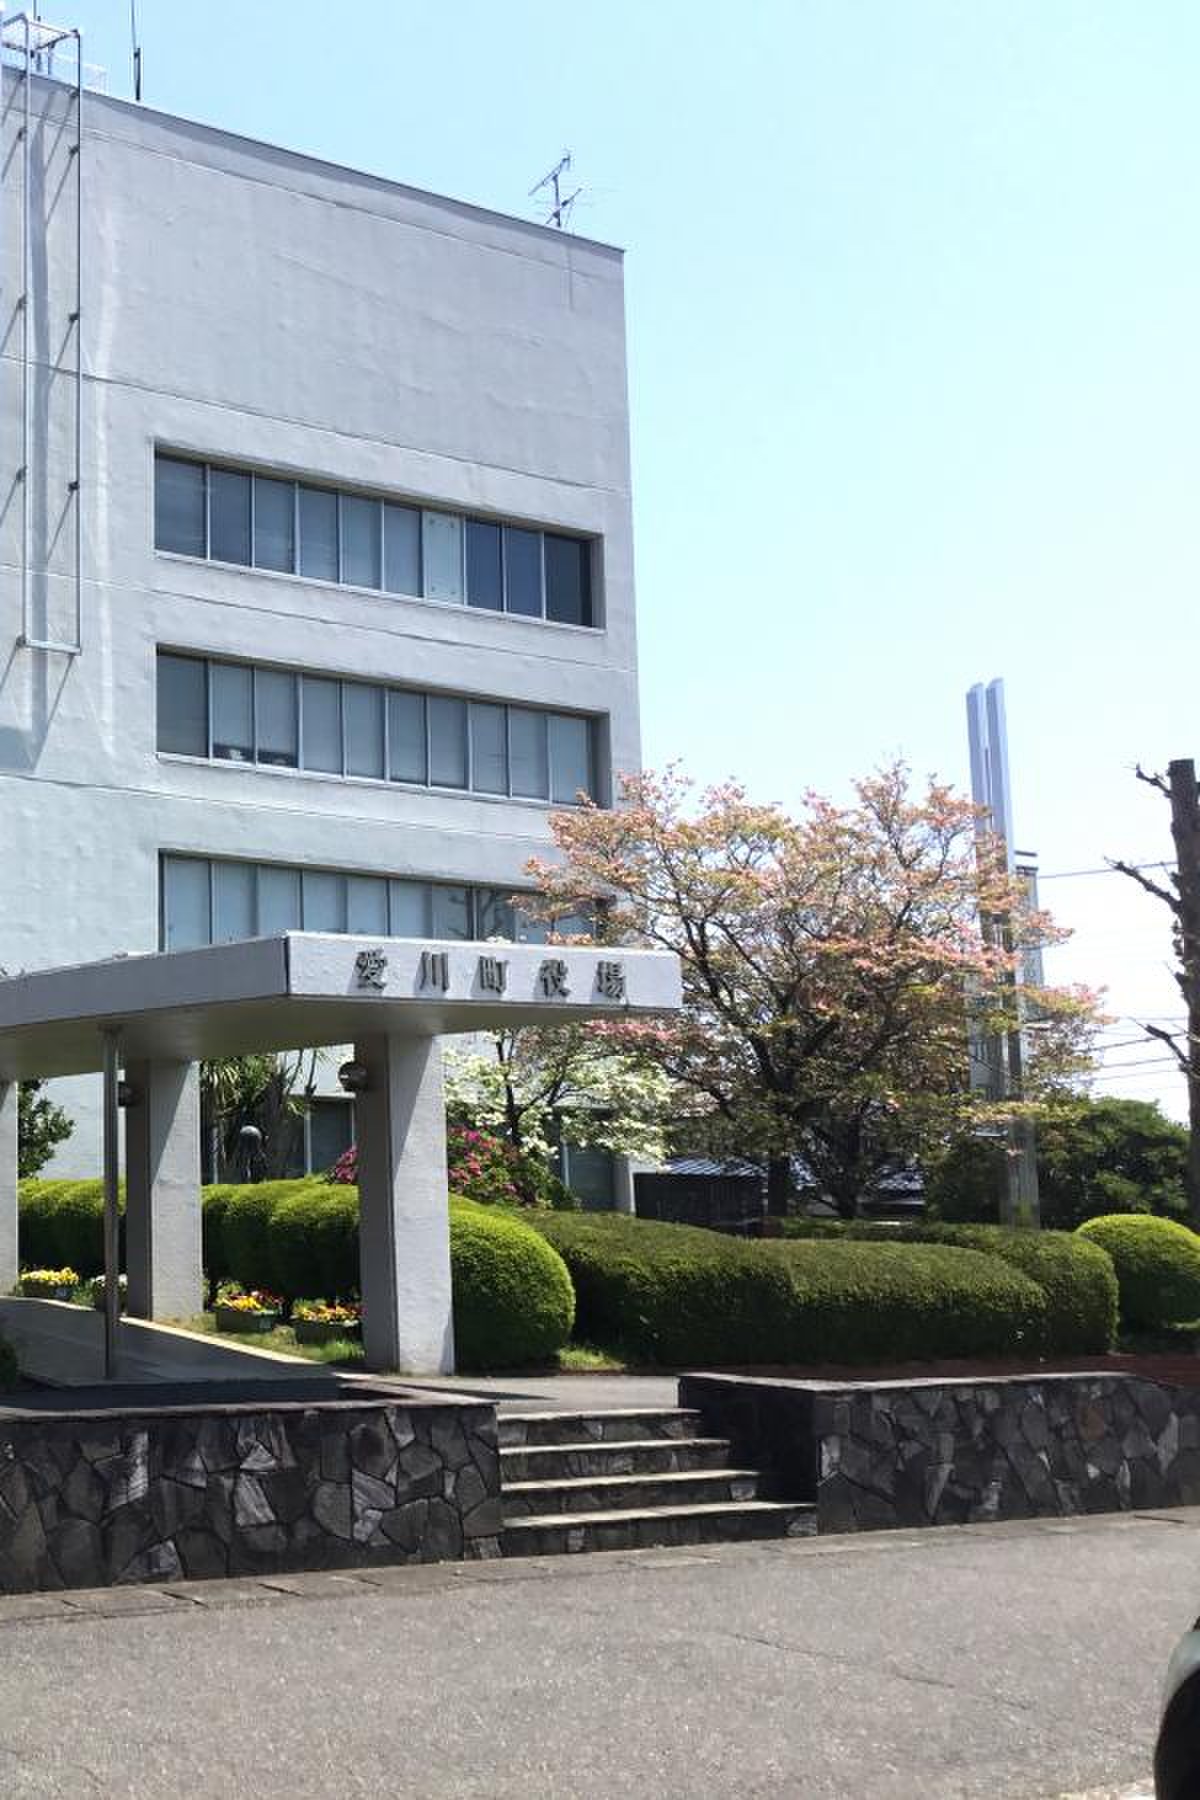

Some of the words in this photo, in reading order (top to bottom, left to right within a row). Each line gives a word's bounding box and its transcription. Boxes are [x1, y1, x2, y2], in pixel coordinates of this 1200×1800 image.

[355, 949, 627, 999] 愛川町役場
